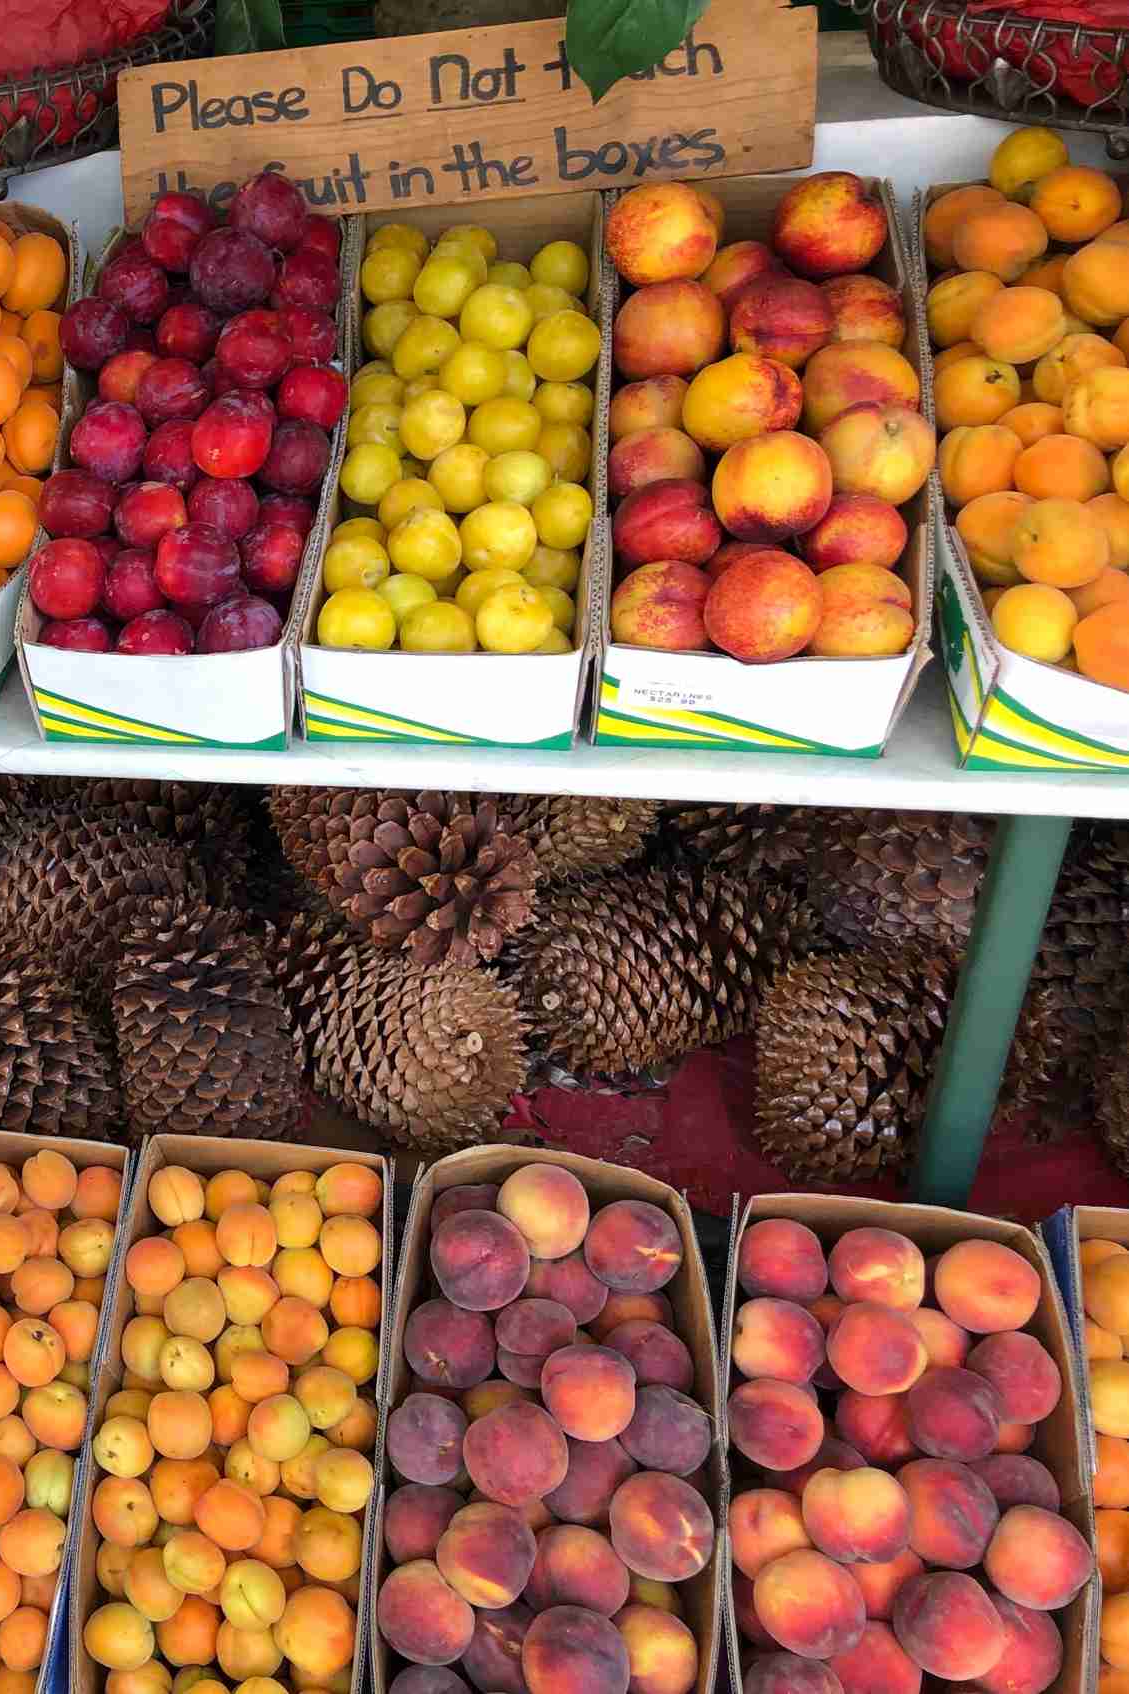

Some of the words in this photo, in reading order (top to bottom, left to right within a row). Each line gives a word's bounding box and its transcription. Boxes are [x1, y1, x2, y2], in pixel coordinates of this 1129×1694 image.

[151, 79, 309, 132] Please
[341, 66, 402, 113] Do
[389, 161, 434, 199] in
[441, 141, 539, 191] the
[554, 126, 727, 182] boxes
